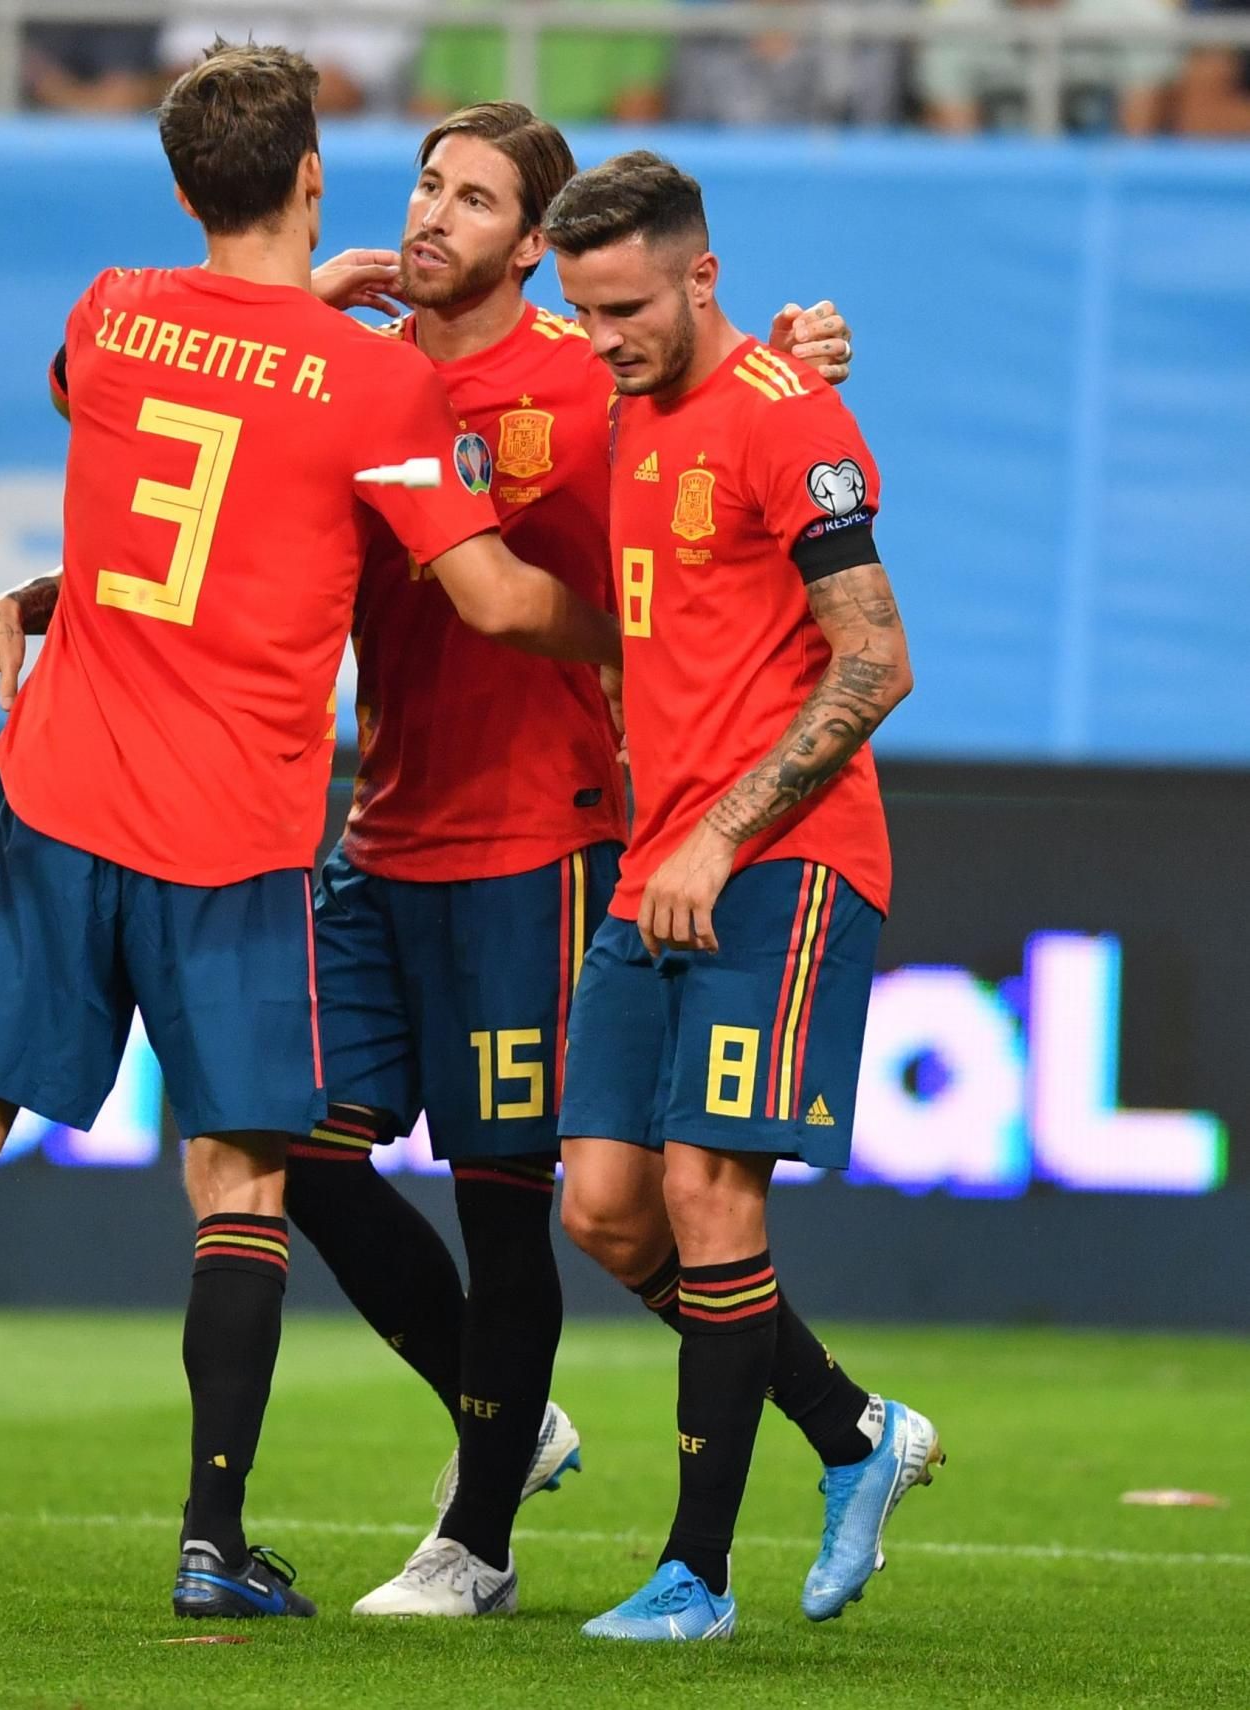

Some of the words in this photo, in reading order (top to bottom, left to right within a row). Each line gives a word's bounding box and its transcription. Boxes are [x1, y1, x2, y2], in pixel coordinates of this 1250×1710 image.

[95, 308, 287, 389] LLORENTE
[96, 397, 243, 628] 3
[622, 547, 654, 638] 8
[470, 1027, 545, 1121] 15
[705, 1024, 760, 1119] 8
